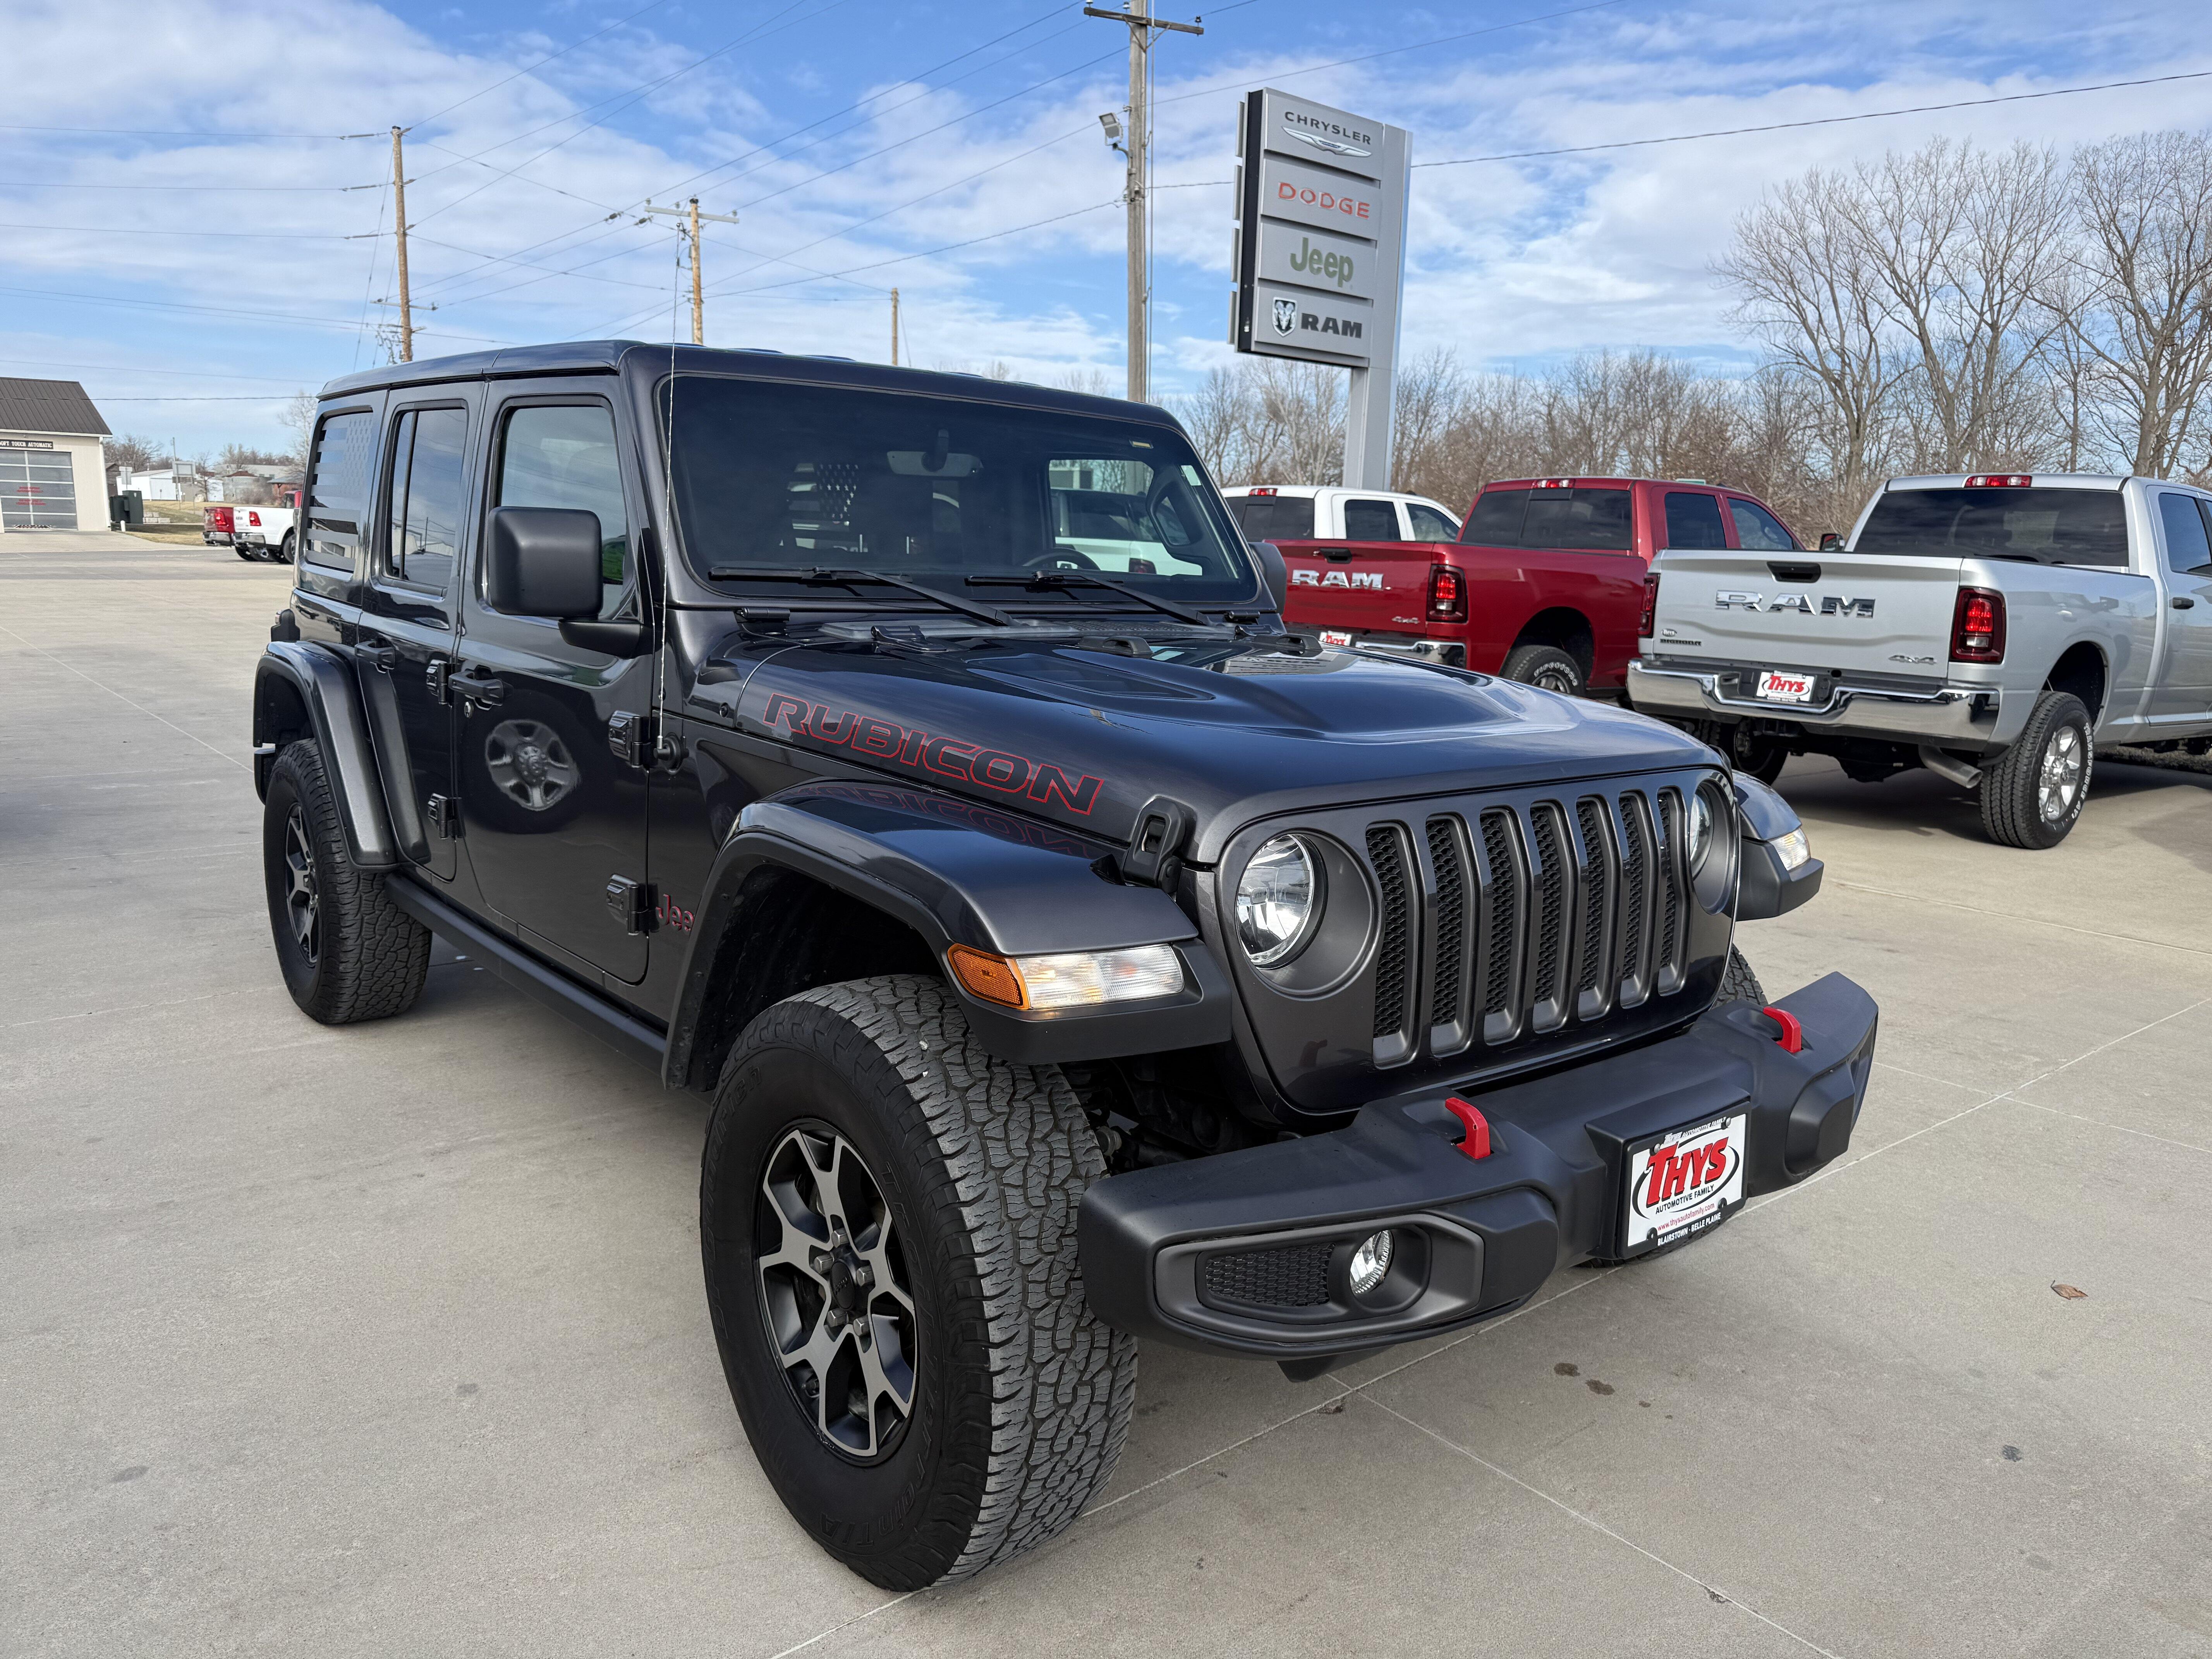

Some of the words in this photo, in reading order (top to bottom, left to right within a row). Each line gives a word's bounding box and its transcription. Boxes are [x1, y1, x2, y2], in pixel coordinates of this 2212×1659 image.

[1285, 112, 1371, 145] CHRYSLER
[1278, 182, 1370, 219] DODGE
[1290, 237, 1354, 288] Jeep
[1301, 313, 1362, 339] RAM
[1292, 570, 1384, 590] RAM
[1715, 590, 1875, 618] RAM
[1767, 675, 1805, 692] THYS
[763, 692, 1104, 815] RUBICON
[655, 894, 694, 935] Jee
[1682, 1123, 1711, 1137] AUTOMOTIVE
[1646, 1137, 1729, 1208] THYS
[1656, 1193, 1693, 1214] AUTOMOTIVE
[1694, 1184, 1714, 1198] FAMILY
[1657, 1203, 1714, 1231] www.thysautofamily.com
[1657, 1227, 1688, 1246] BLAIRSTOWN
[1691, 1219, 1705, 1232] BELLE
[1705, 1212, 1721, 1226] PLAINE
